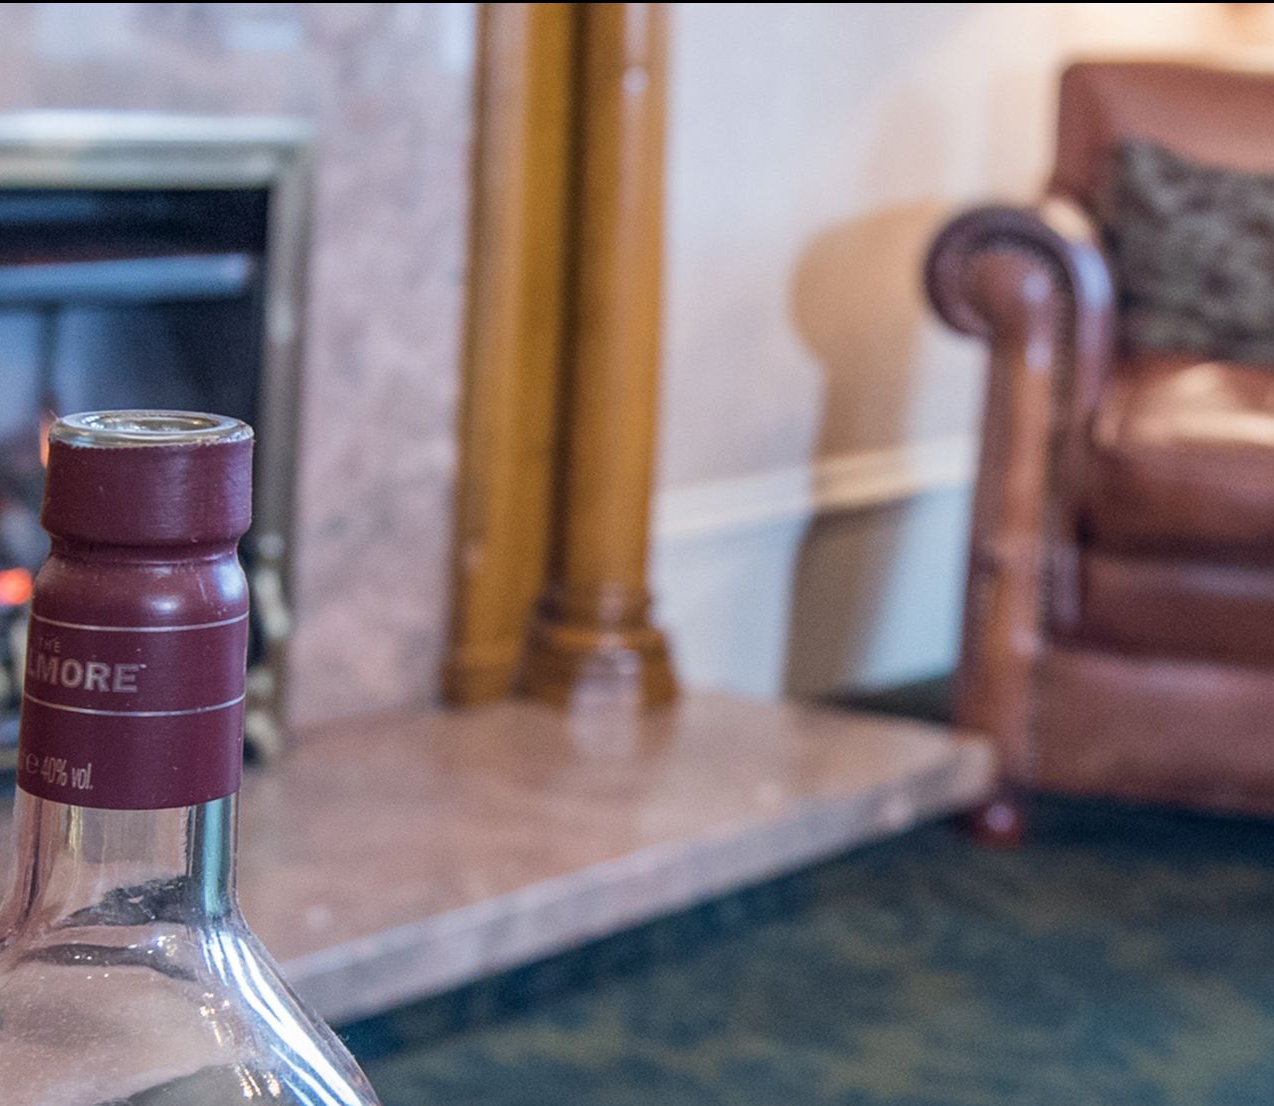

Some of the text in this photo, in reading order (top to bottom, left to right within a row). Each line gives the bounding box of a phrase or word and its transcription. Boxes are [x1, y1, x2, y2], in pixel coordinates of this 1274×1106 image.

[38, 636, 62, 654] THE
[39, 755, 68, 787] 40%
[71, 762, 94, 790] vol.
